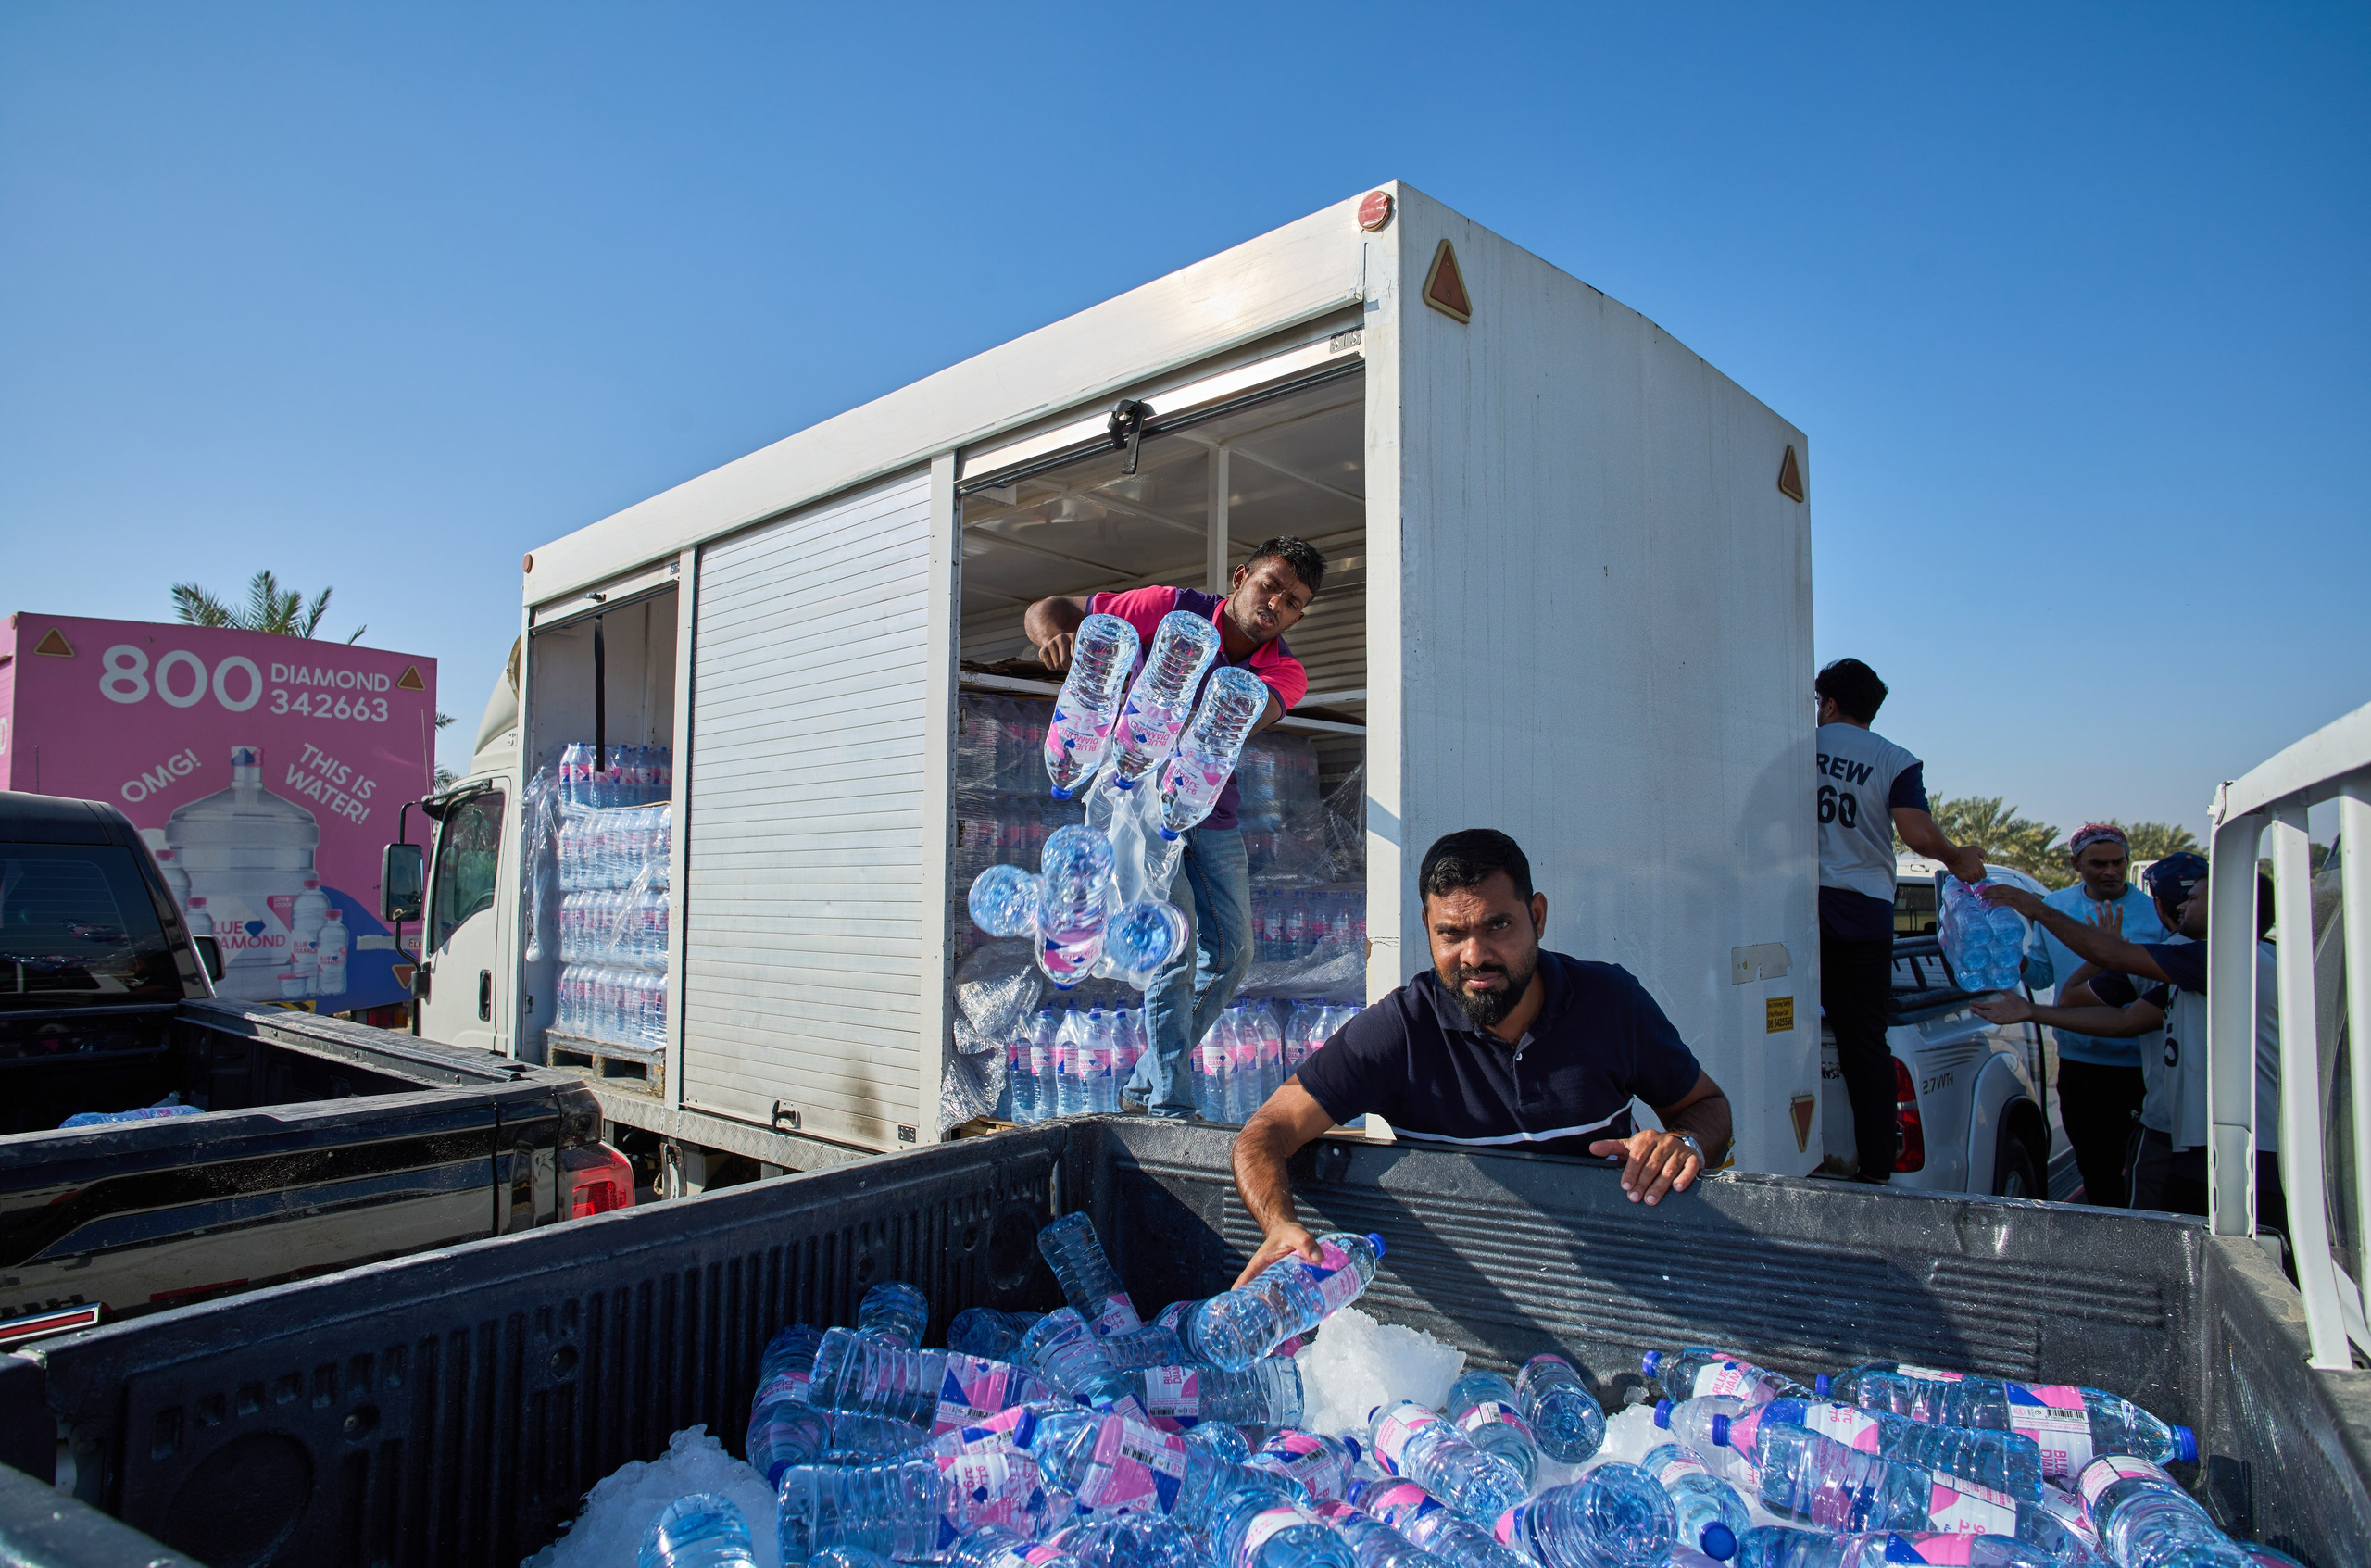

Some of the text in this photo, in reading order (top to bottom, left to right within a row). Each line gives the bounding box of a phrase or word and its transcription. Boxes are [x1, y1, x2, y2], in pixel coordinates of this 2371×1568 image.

[99, 644, 263, 712] 800
[270, 663, 390, 693] DIAMOND
[270, 689, 389, 722] 342663
[1058, 726, 1099, 745] DIAMOND
[1129, 720, 1170, 741] DIAMOND
[1147, 737, 1168, 748] BLUE
[1079, 743, 1098, 753] BLUE
[121, 748, 202, 803] OMG!
[298, 742, 377, 800] THIS IS
[1816, 752, 1875, 787] REW
[284, 763, 370, 825] WATER!
[1817, 784, 1857, 829] 60
[1712, 1369, 1730, 1395] BLUE
[2053, 1449, 2069, 1475] BLUE
